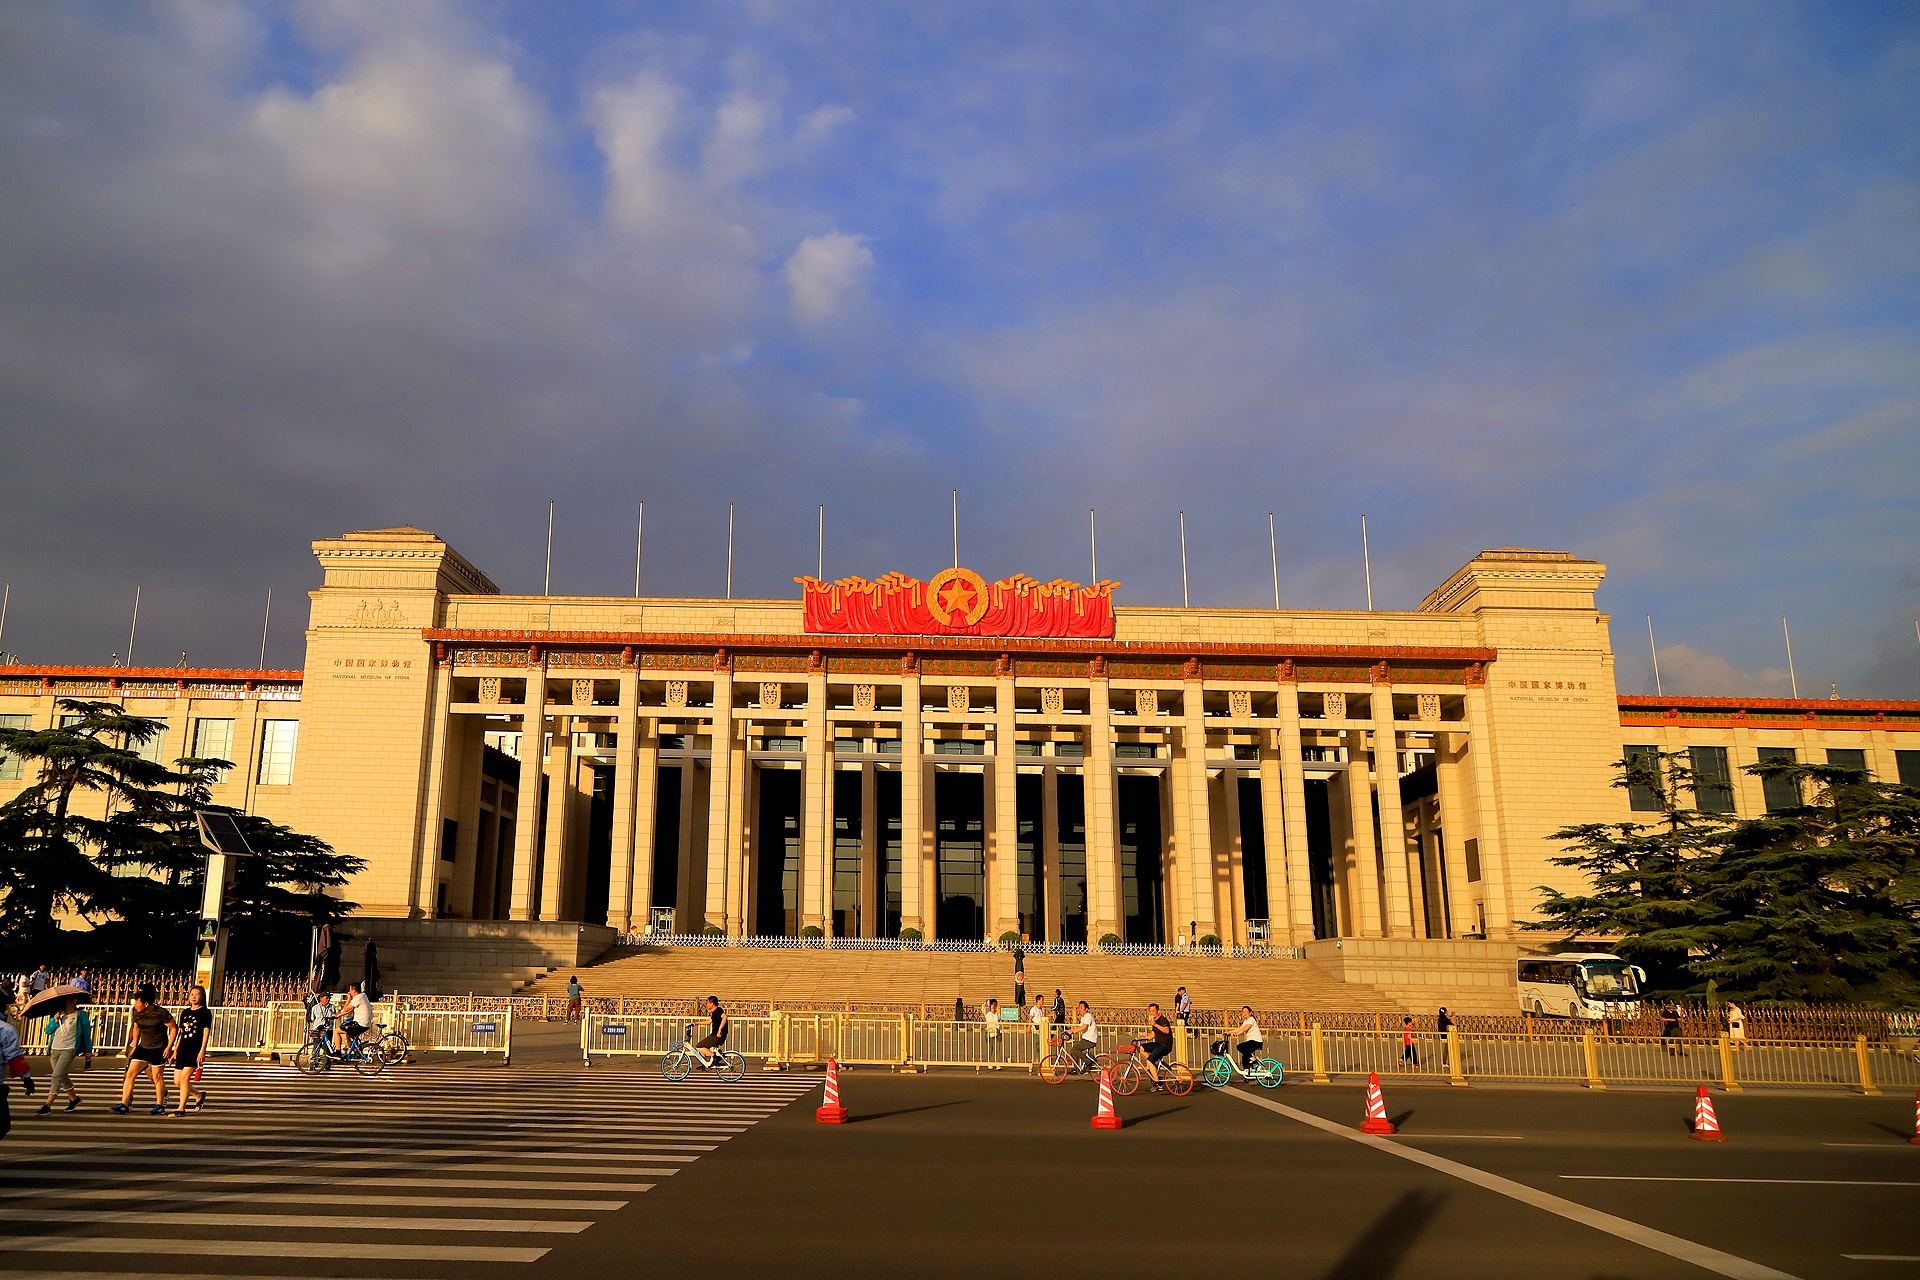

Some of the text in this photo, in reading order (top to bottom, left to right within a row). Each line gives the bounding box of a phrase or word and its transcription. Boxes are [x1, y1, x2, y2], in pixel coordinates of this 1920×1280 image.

[334, 659, 411, 668] 中国国家博物馆
[1508, 681, 1587, 690] 中国国家博物馆
